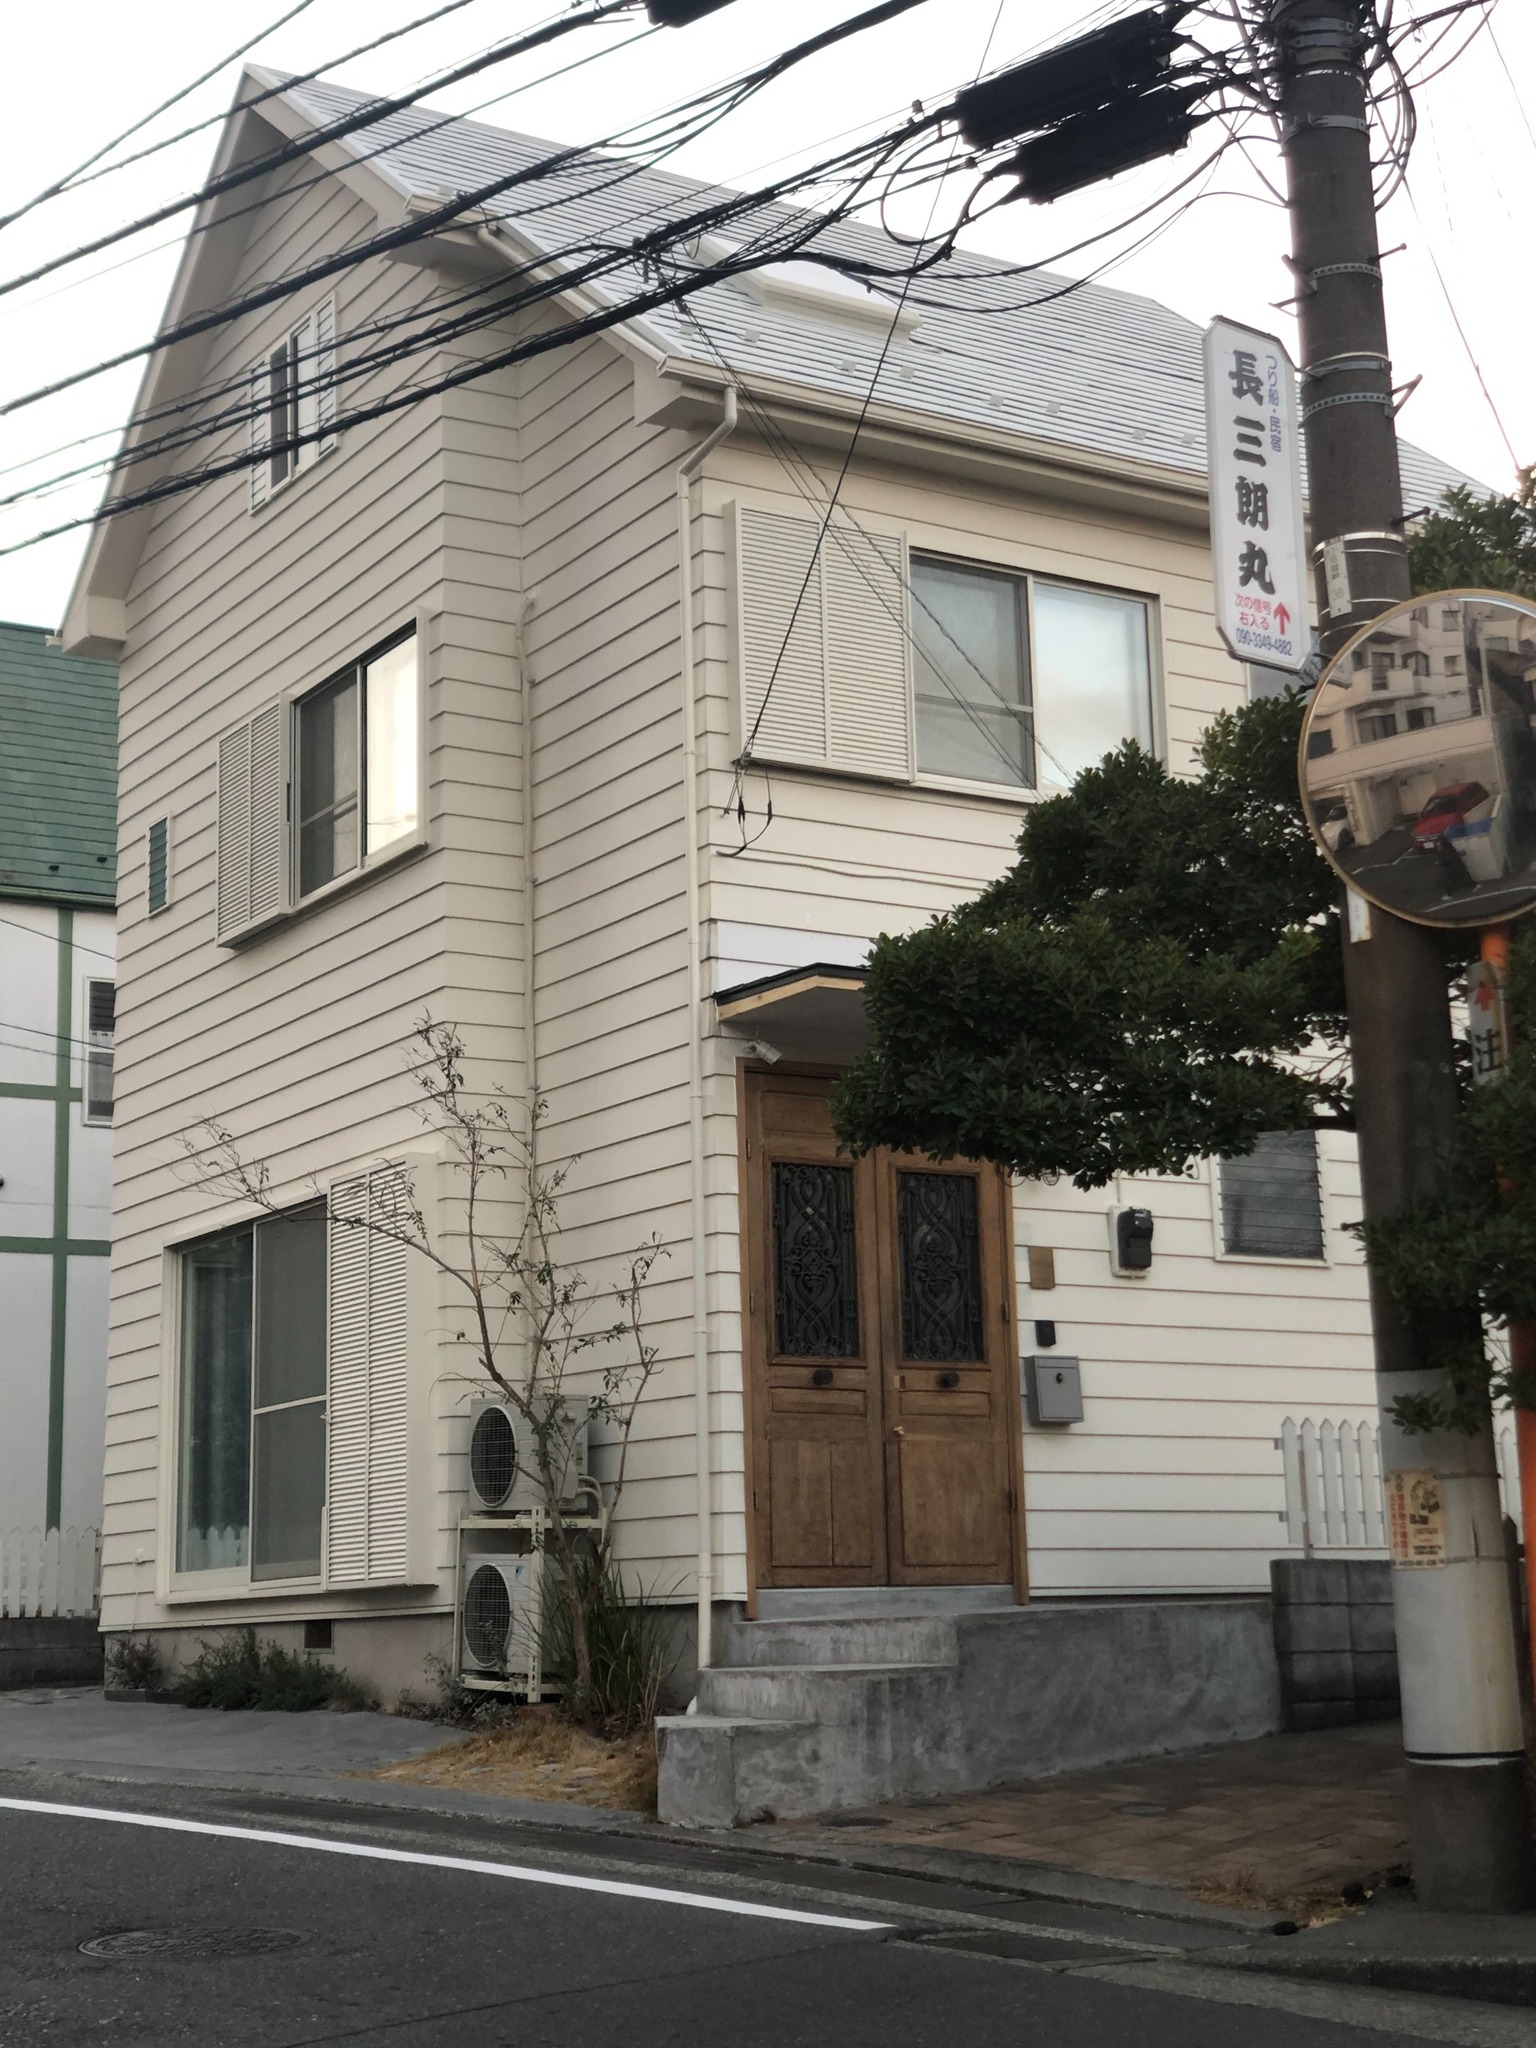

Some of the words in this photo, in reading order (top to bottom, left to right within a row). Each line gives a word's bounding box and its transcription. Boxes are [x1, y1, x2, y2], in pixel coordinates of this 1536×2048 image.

[1265, 355, 1282, 453] つり船・民宿
[1228, 349, 1275, 595] 長三朗丸
[1235, 593, 1272, 616] 次の信号
[1238, 611, 1270, 631] 右入る
